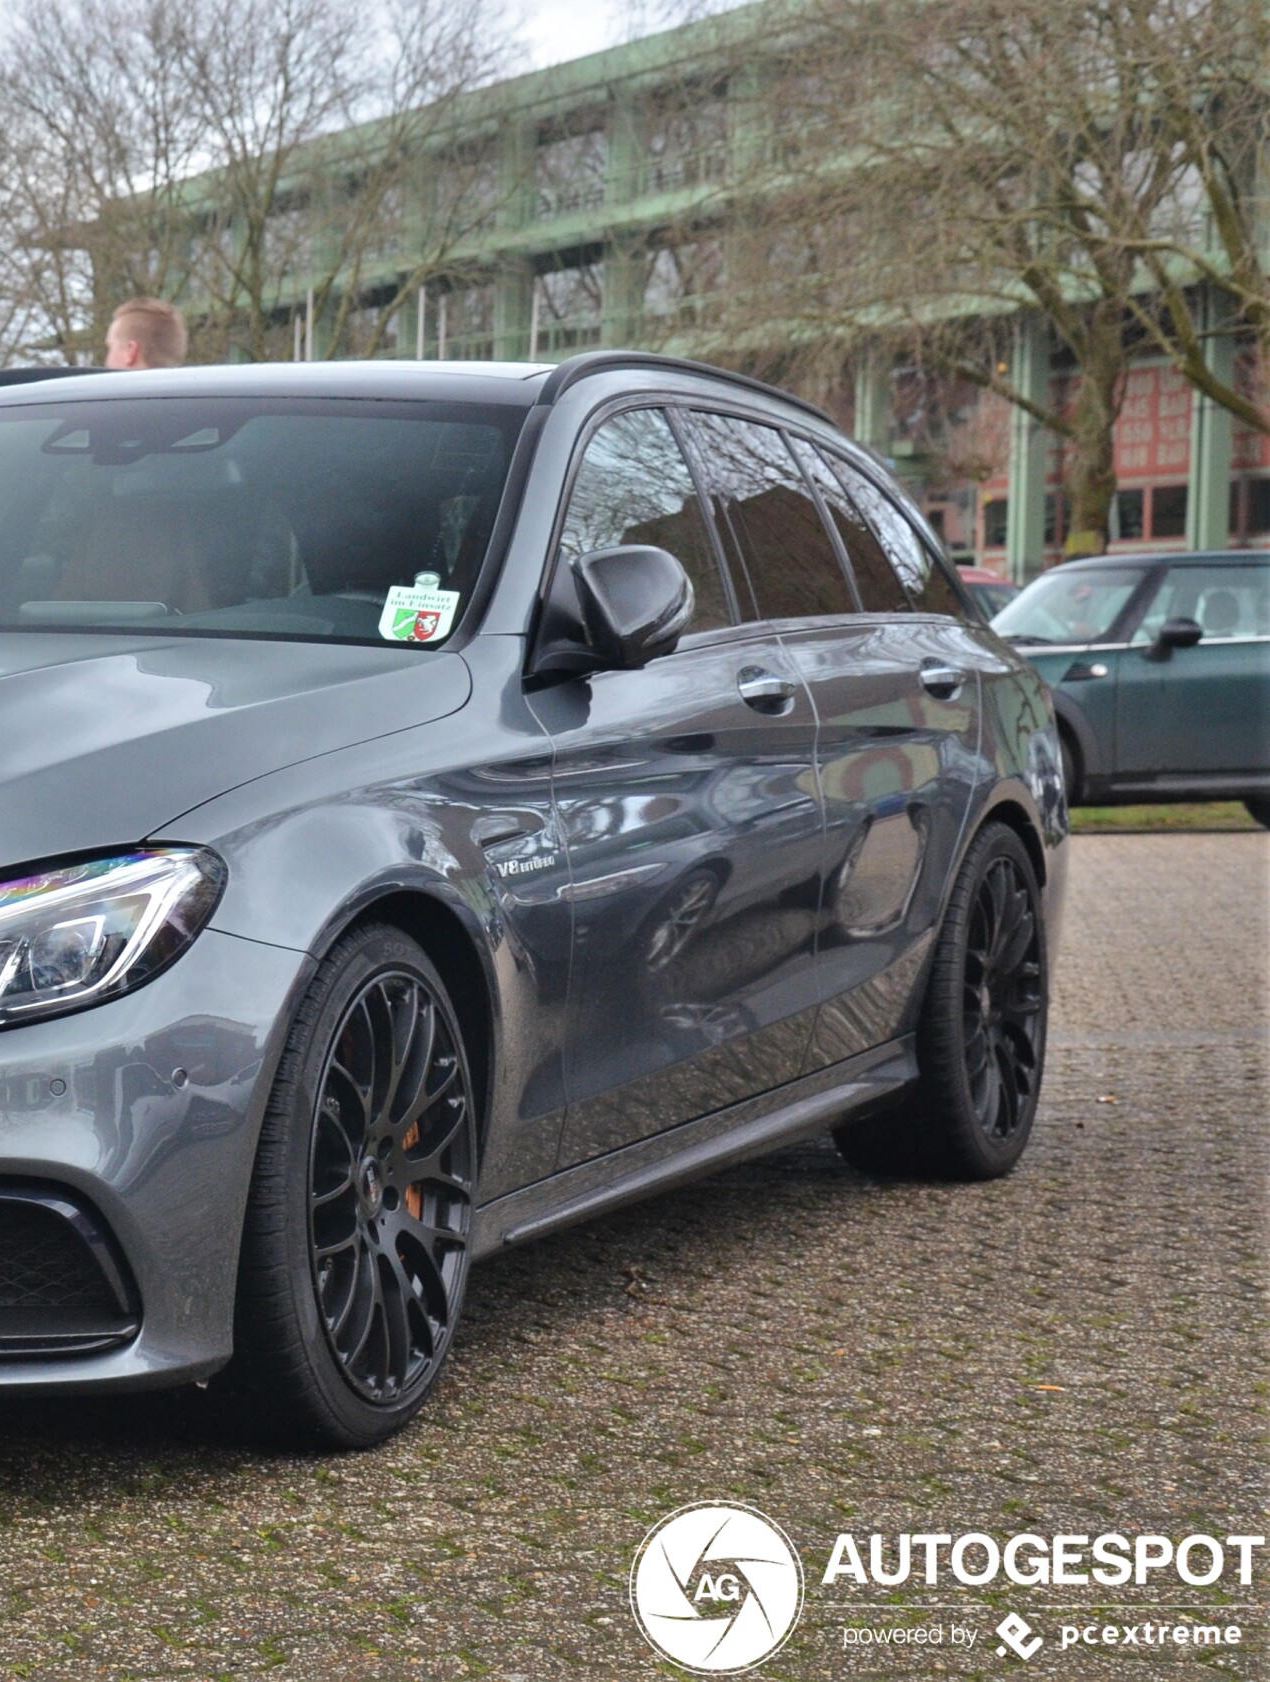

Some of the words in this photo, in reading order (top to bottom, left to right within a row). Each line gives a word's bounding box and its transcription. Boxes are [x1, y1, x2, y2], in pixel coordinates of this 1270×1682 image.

[397, 592, 451, 602] Landwirt
[409, 600, 451, 611] Einsatz
[496, 860, 520, 878] V8
